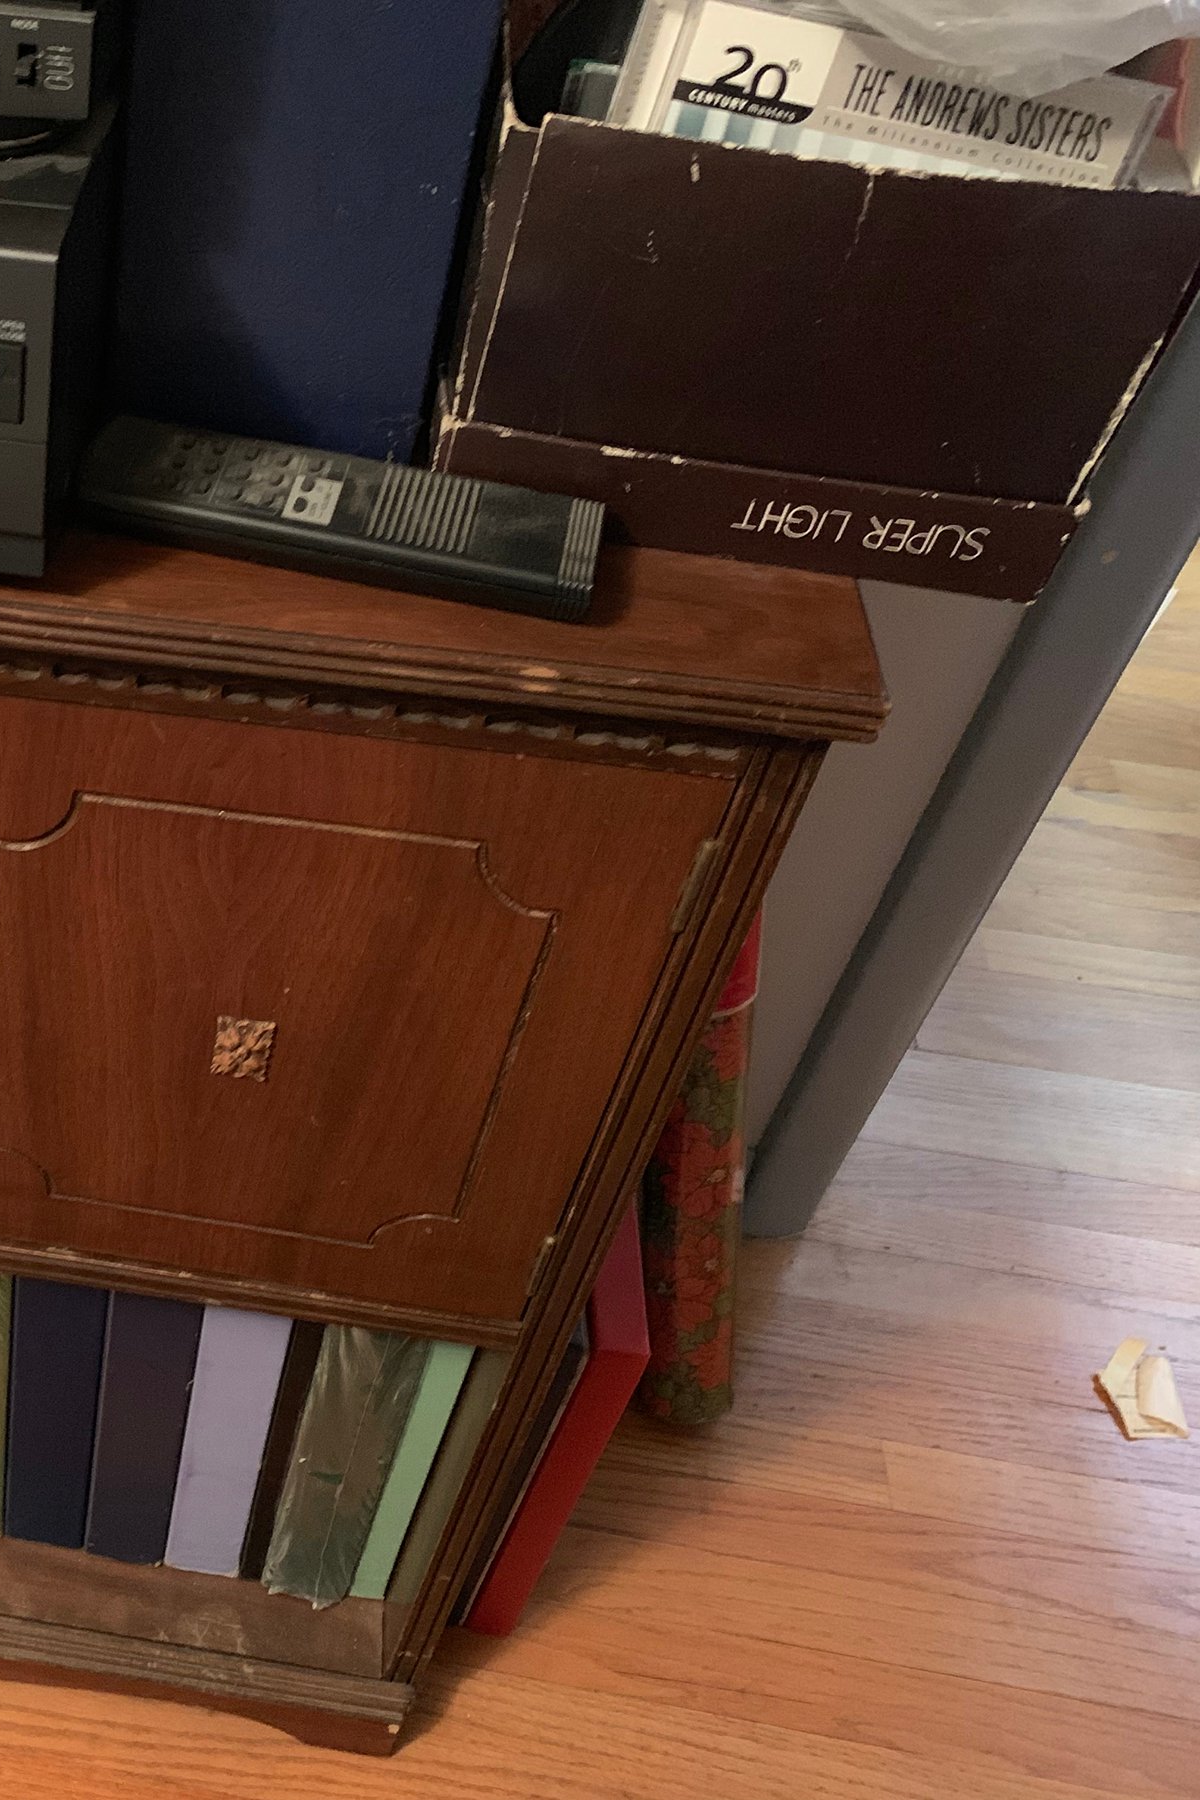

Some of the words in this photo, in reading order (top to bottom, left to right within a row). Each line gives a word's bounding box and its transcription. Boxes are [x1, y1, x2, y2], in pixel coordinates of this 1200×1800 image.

[687, 87, 748, 112] CENTURY
[746, 102, 797, 124] masters
[842, 62, 896, 117] THE
[888, 73, 1009, 142] ANDREWS
[1005, 98, 1113, 163] SISTERS
[822, 113, 855, 131] The
[990, 150, 1101, 185] Collection
[729, 497, 853, 544] LIGHT
[861, 514, 992, 562] SUPER
